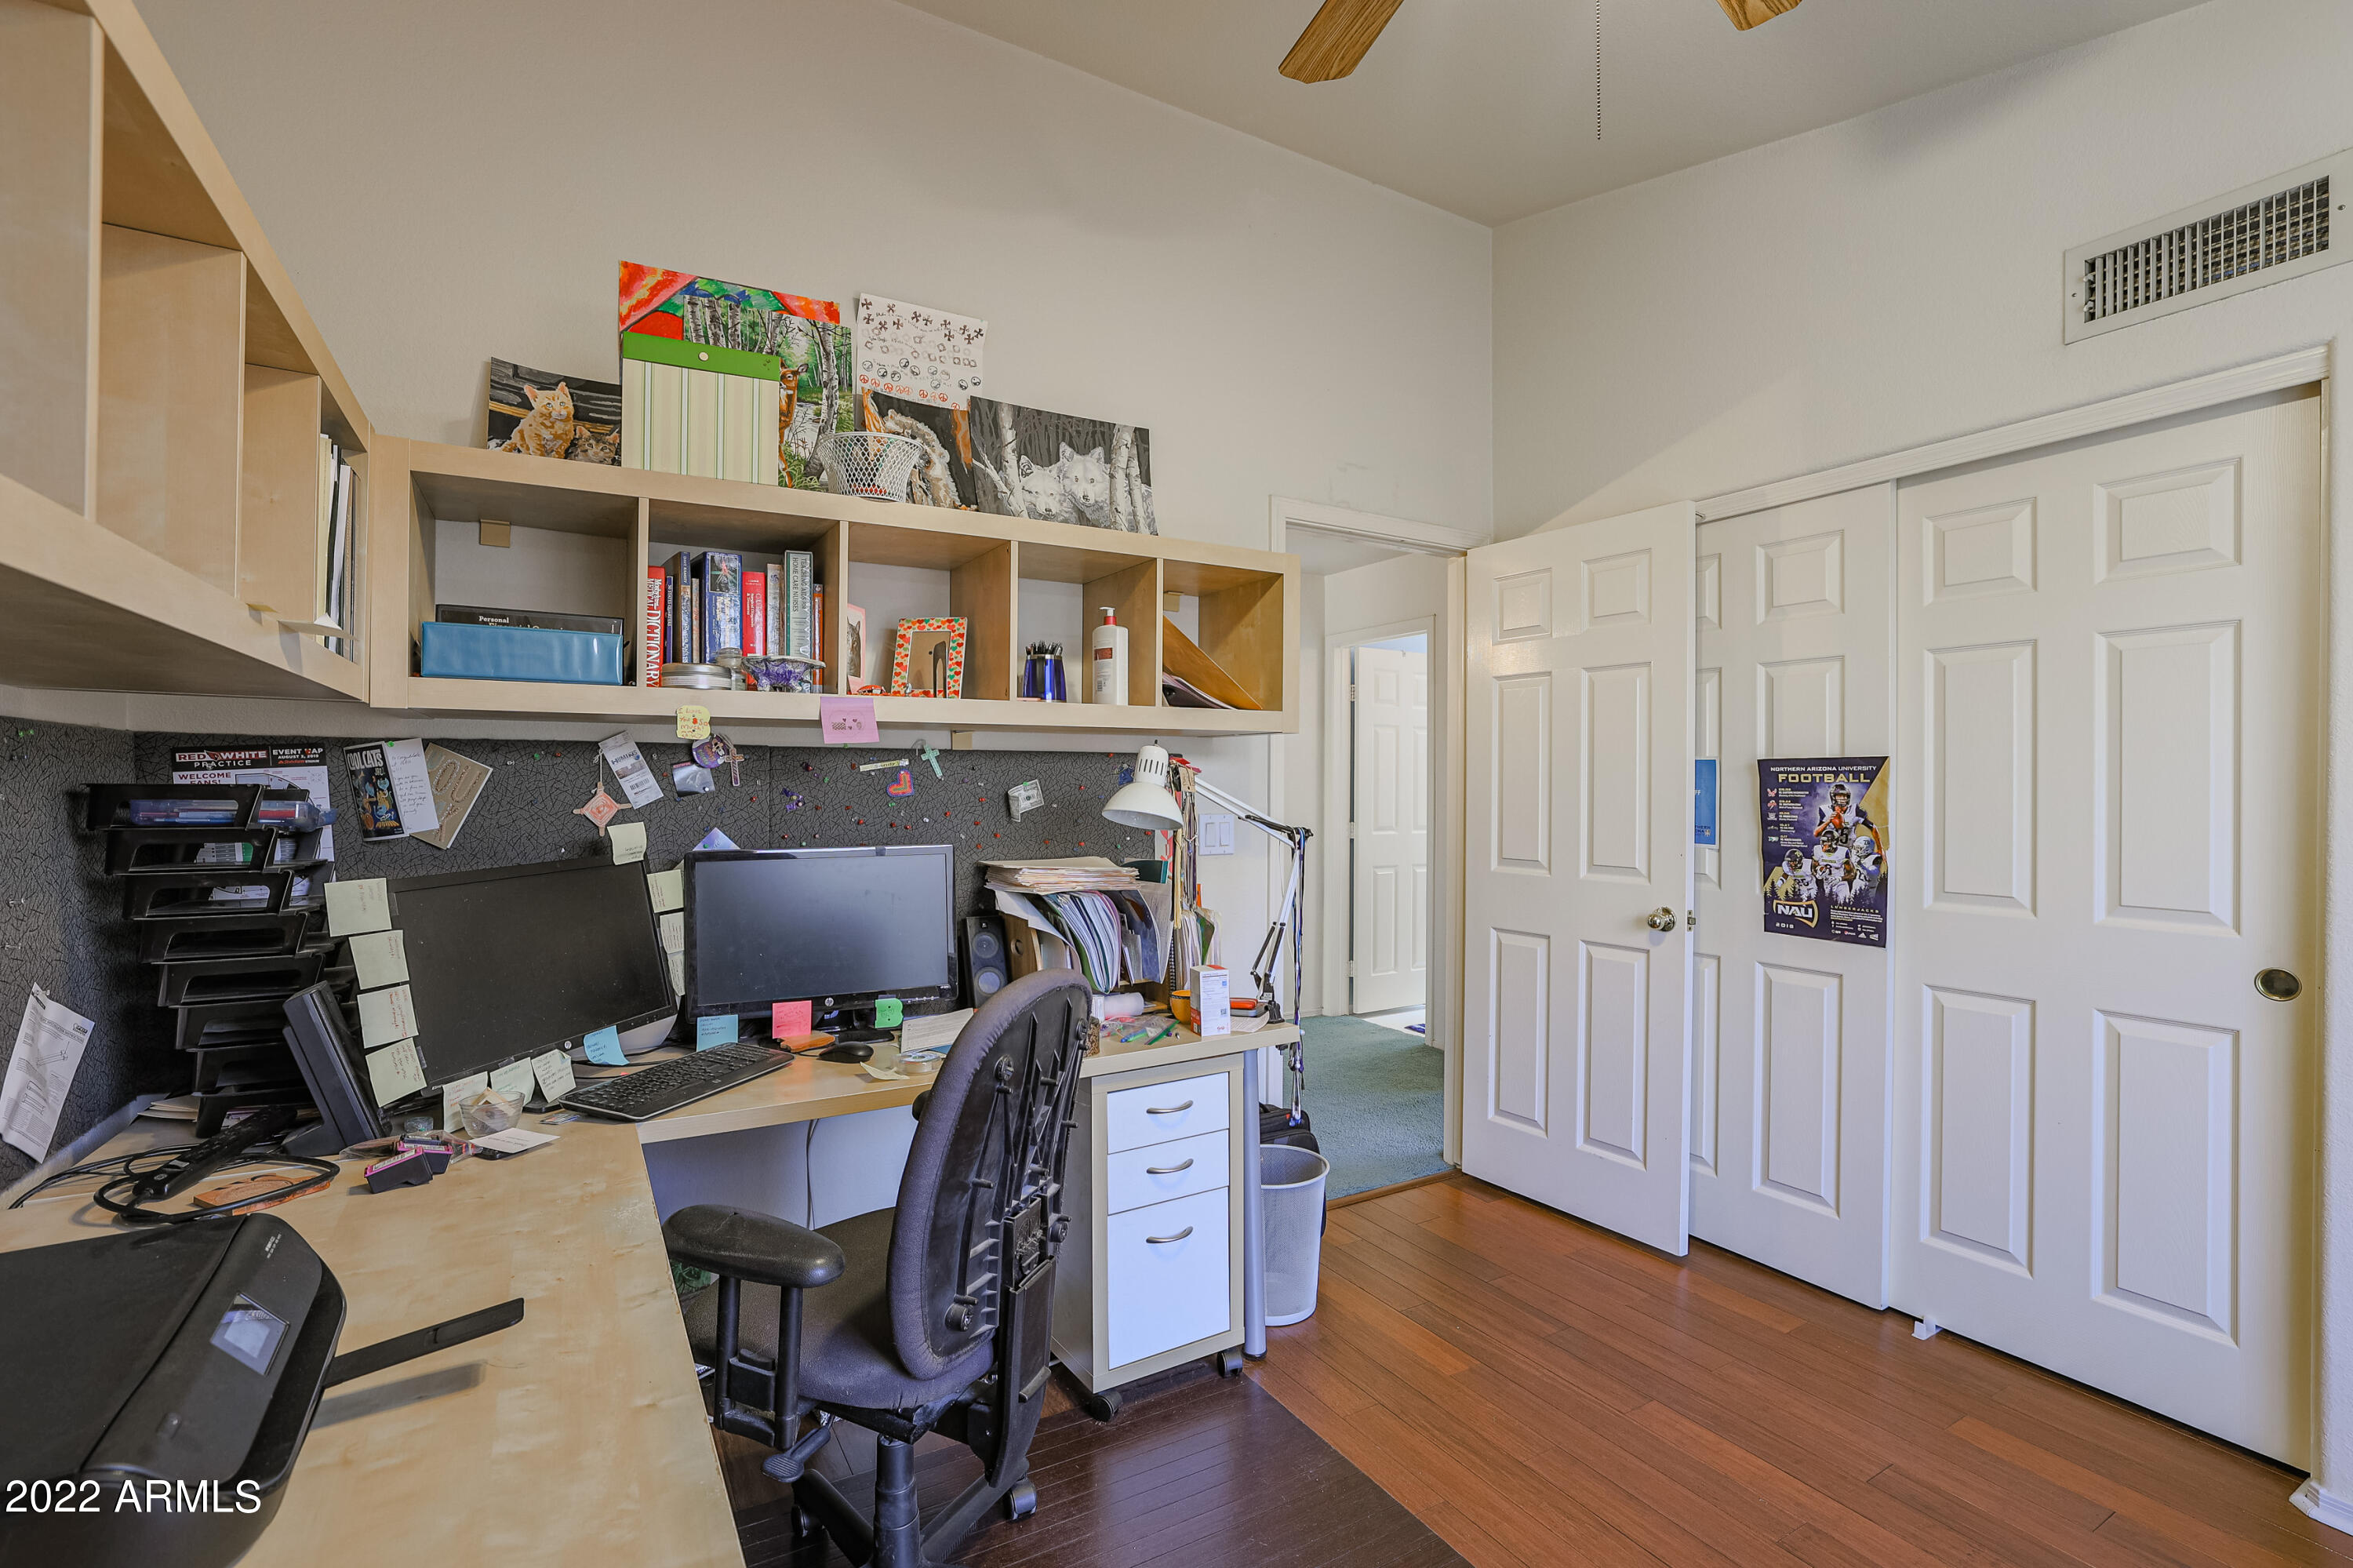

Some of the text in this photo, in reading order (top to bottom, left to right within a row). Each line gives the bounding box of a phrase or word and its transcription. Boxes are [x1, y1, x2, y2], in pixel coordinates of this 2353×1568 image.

[646, 610, 661, 687] DICTIONARY
[177, 751, 267, 761] RED WHITE
[194, 759, 252, 768] PRACTICE
[1778, 773, 1871, 783] FOOTBALL
[1777, 905, 1813, 919] NAU
